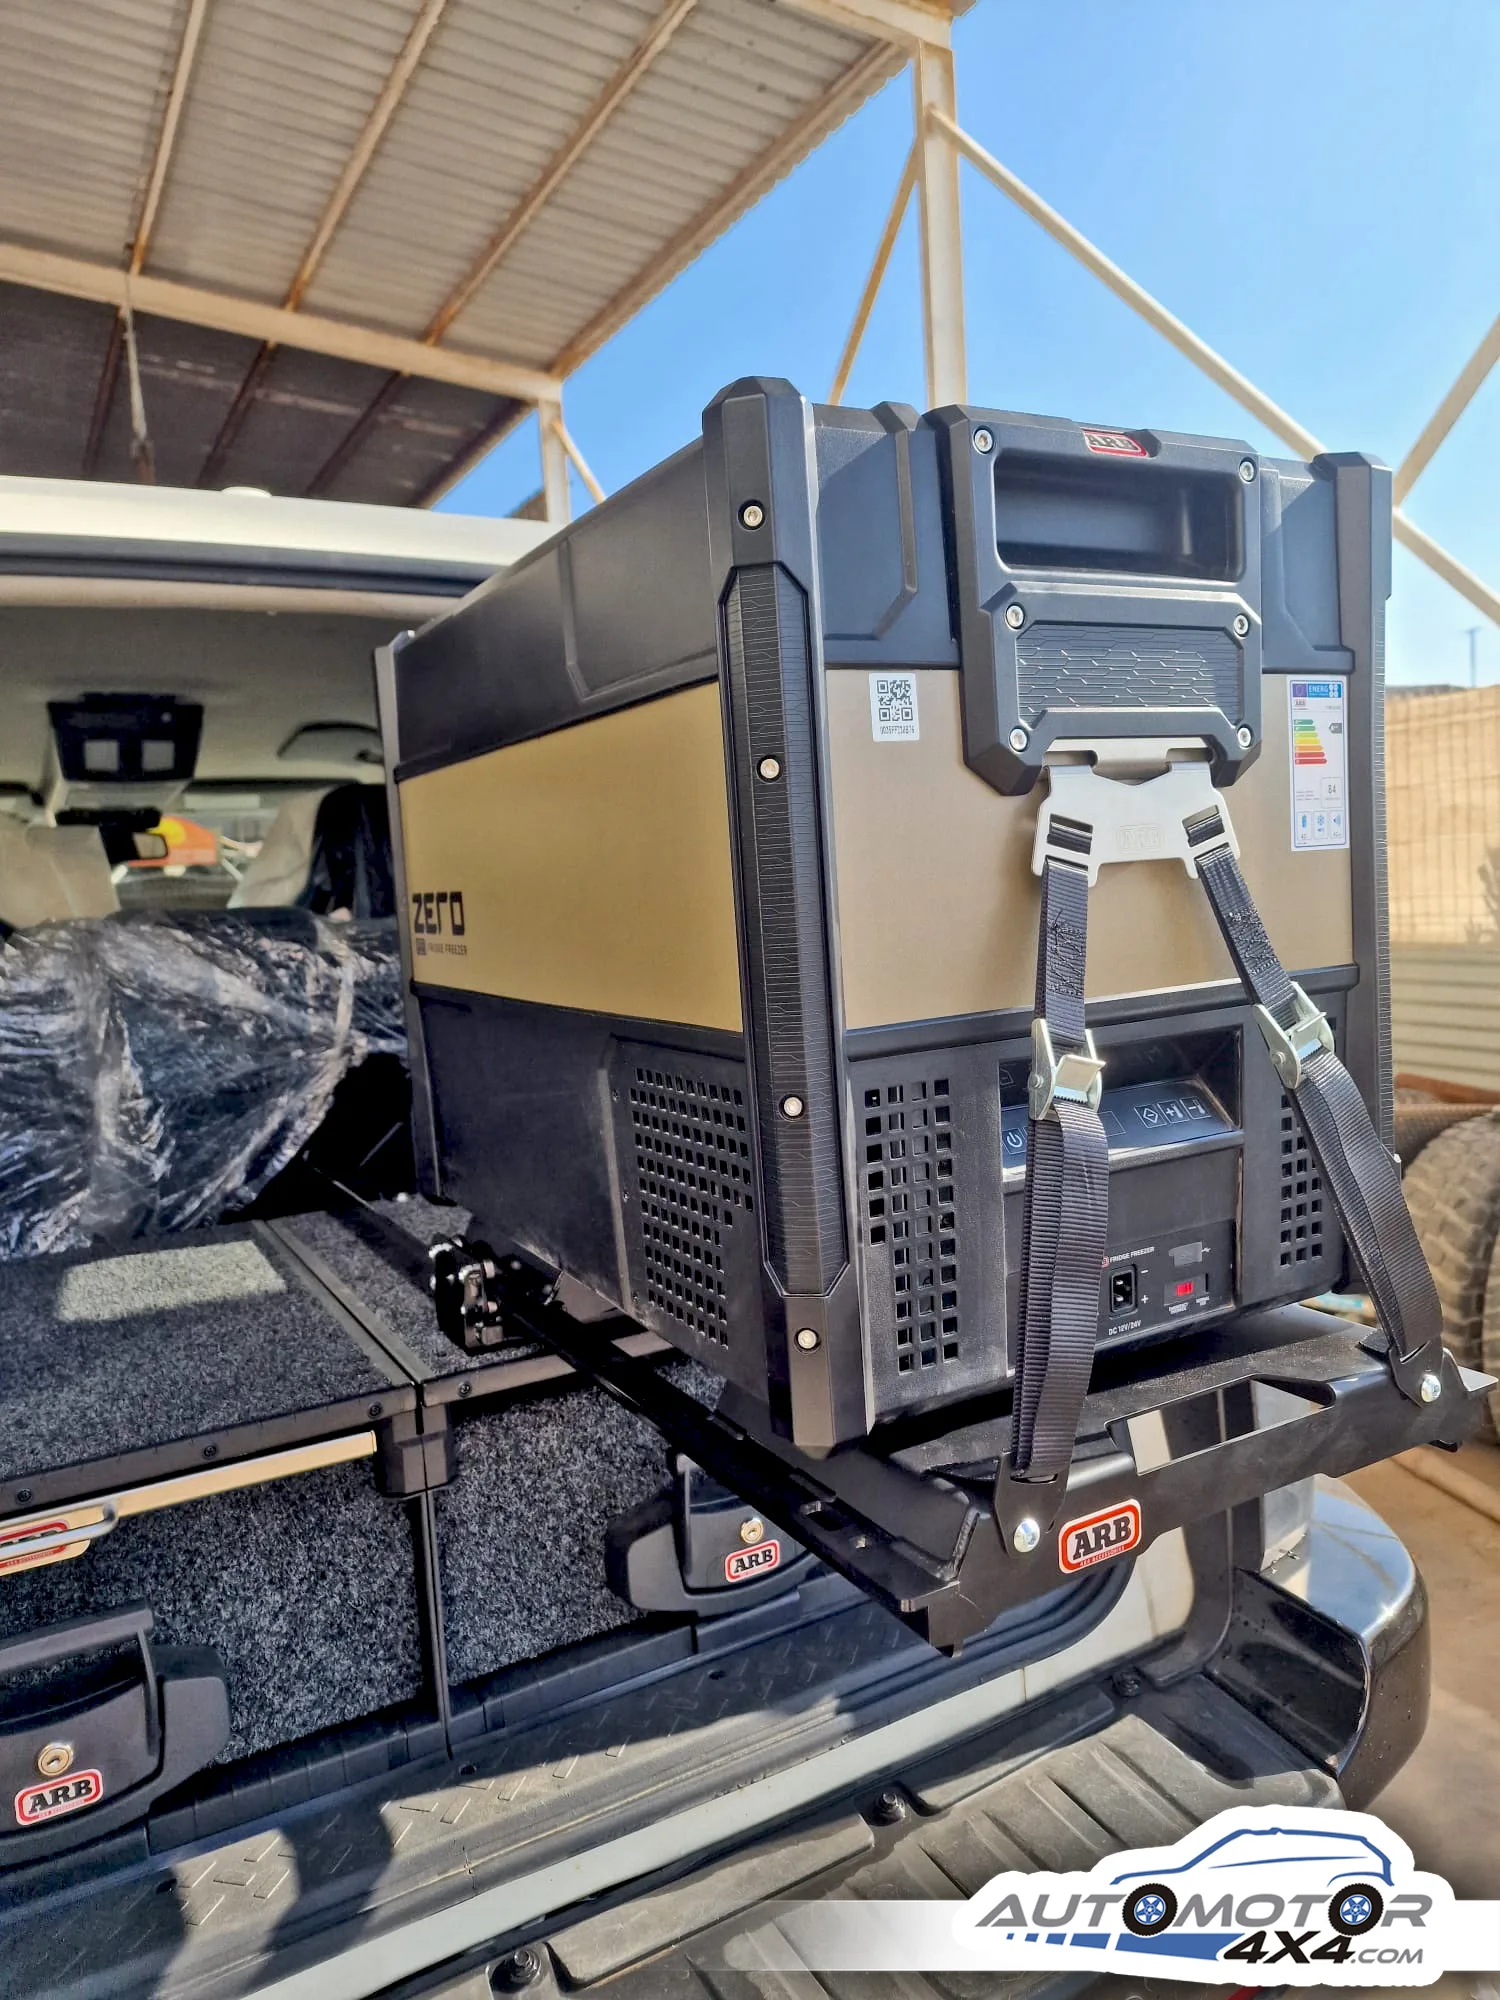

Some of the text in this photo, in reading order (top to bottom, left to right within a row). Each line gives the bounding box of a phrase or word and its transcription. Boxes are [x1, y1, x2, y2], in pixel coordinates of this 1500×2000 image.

[1109, 1252, 1130, 1263] FRIDGE
[1130, 1246, 1155, 1257] FREEZER
[1108, 1320, 1142, 1336] DC 12V/24V
[1073, 1516, 1132, 1561] ARB
[733, 1548, 773, 1574] ARB
[28, 1779, 93, 1815] ARB
